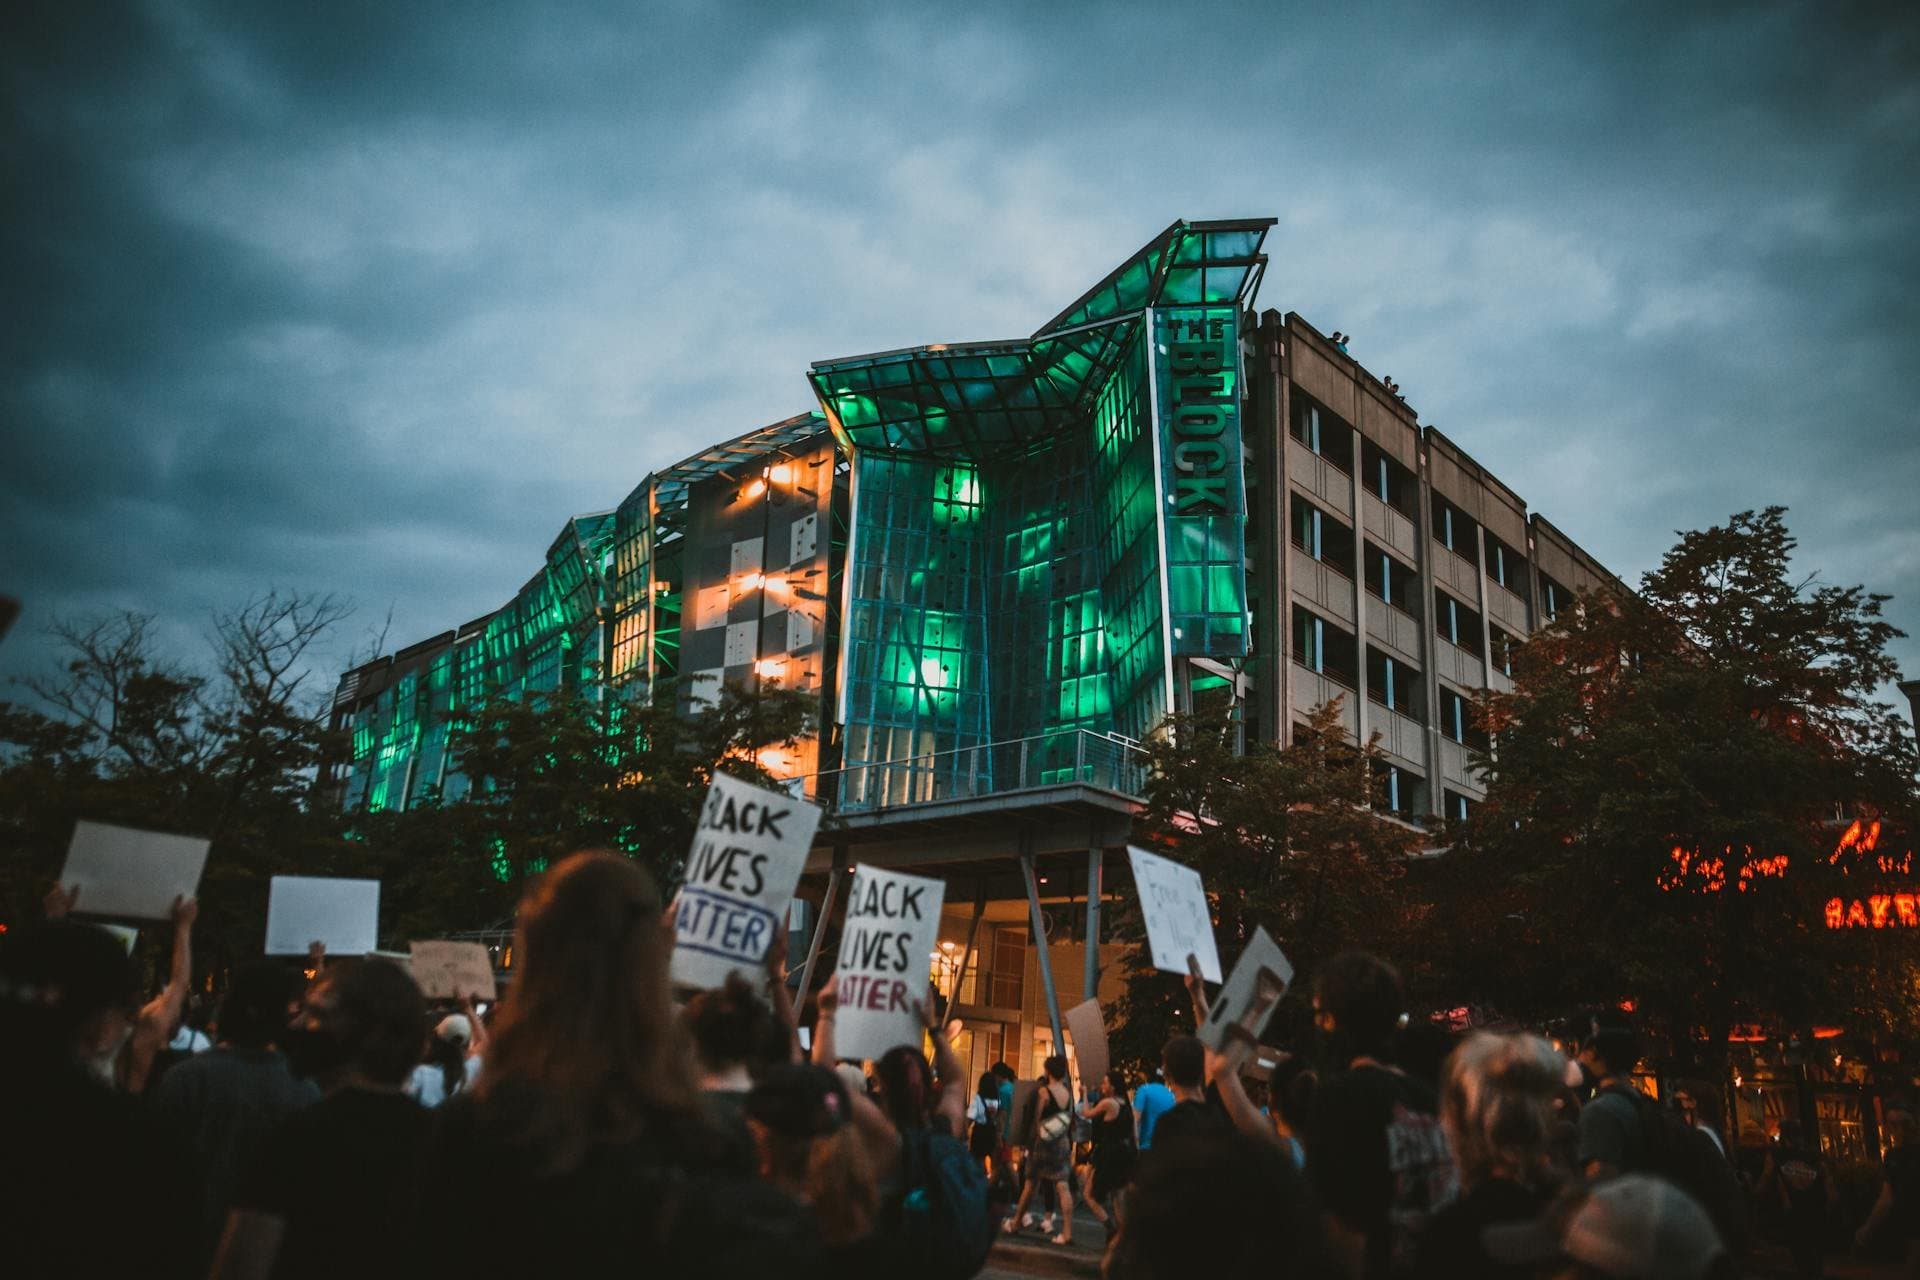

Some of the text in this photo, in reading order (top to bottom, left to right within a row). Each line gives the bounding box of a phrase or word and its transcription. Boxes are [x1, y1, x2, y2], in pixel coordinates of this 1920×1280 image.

[1167, 317, 1225, 340] THE
[1169, 342, 1228, 511] BLOCK
[689, 841, 768, 896] IVES
[675, 898, 766, 954] ATTER
[838, 974, 909, 1014] ATTER
